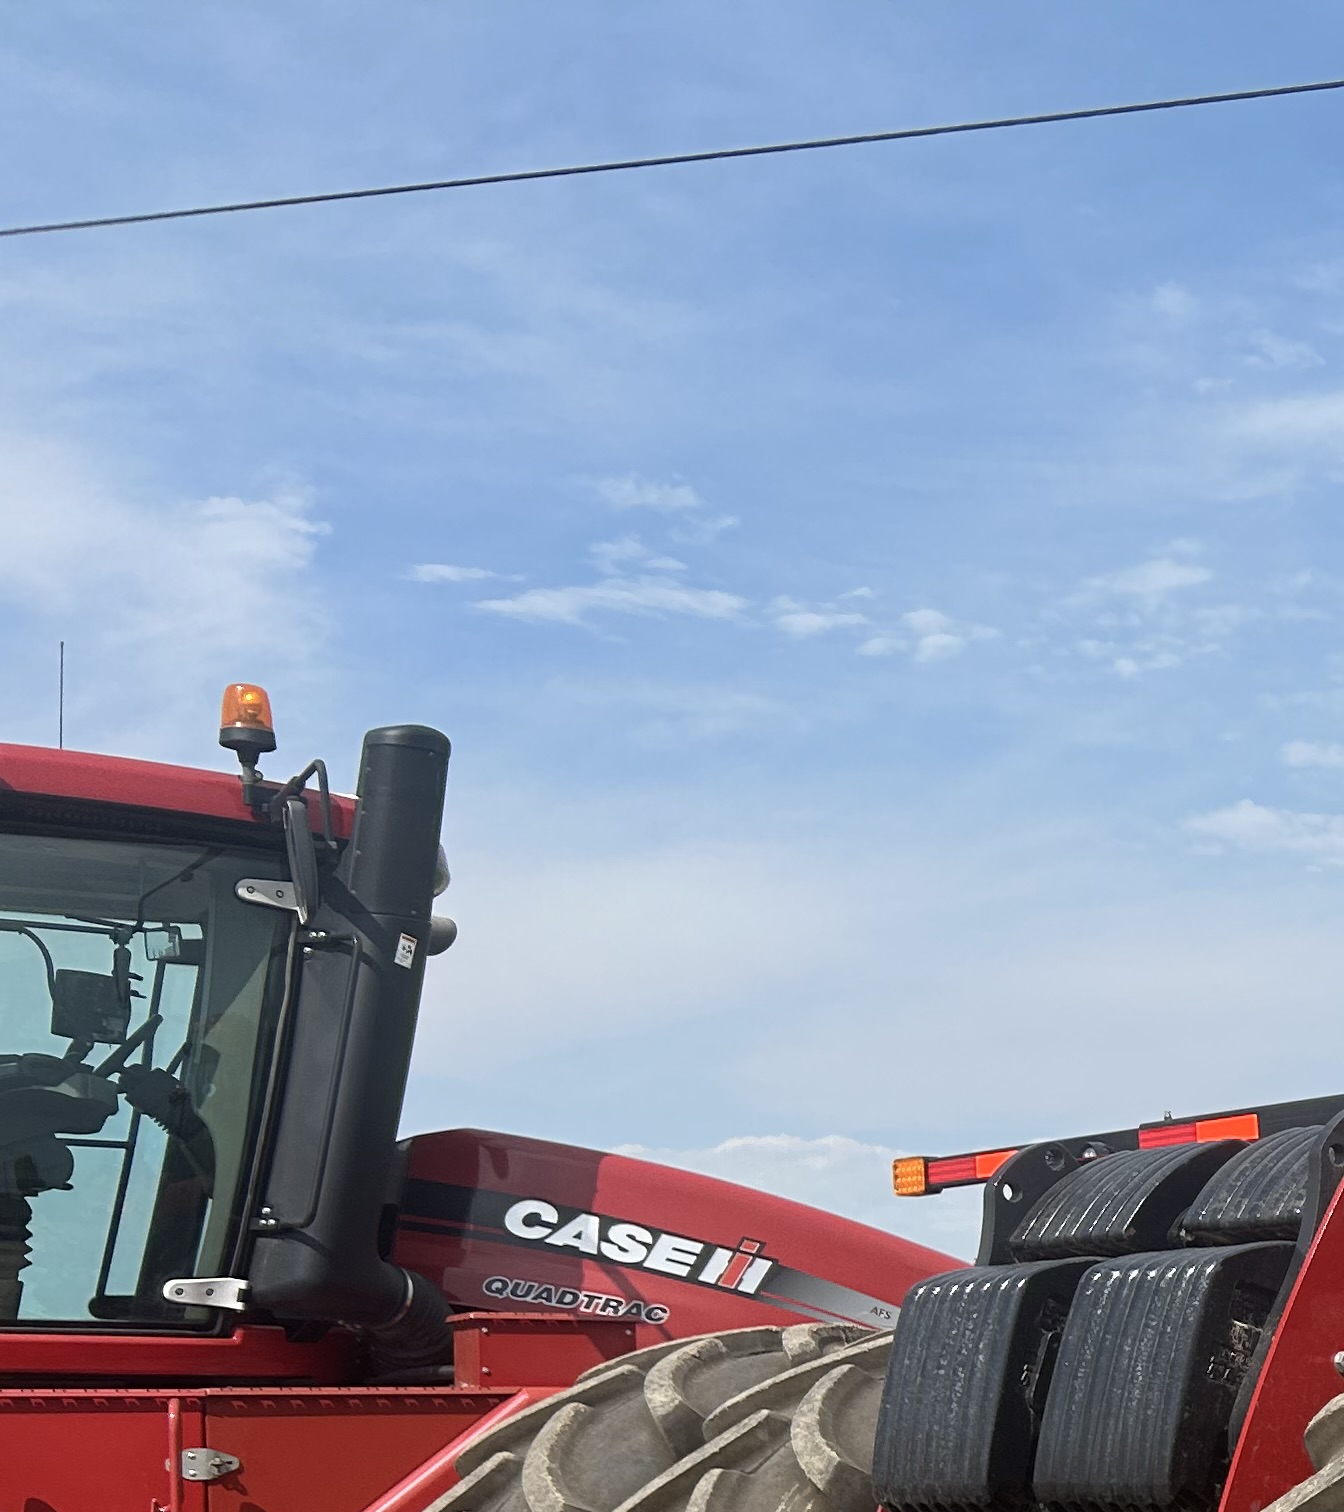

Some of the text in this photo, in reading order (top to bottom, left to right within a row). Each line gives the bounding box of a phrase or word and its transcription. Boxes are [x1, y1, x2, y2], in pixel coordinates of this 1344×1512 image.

[504, 1200, 704, 1277] CASE
[482, 1276, 670, 1325] QUADTRAC
[870, 1306, 892, 1320] AFS
